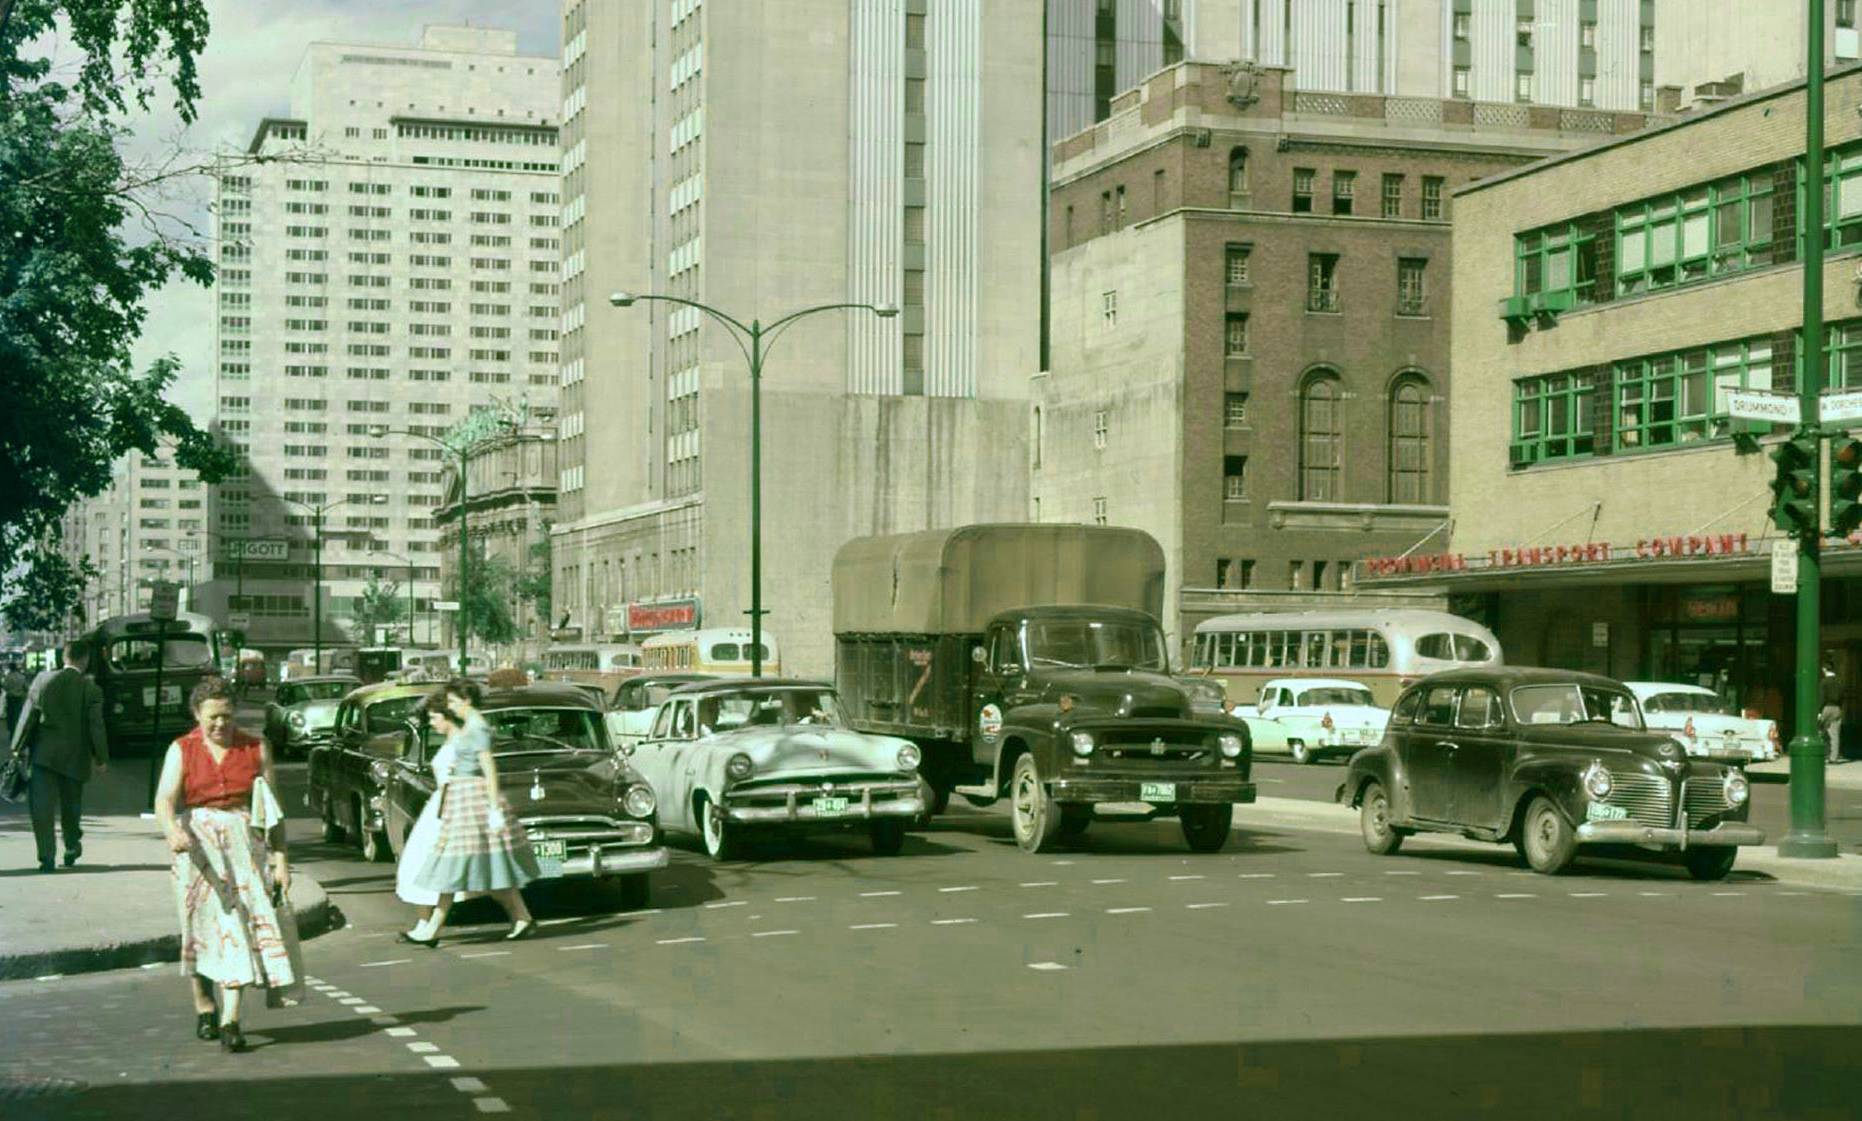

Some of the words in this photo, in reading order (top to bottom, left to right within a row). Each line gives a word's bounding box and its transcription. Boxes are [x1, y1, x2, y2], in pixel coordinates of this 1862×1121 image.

[1733, 399, 1787, 416] DRUMMOND
[1488, 542, 1611, 567] TRANSPORT
[1636, 533, 1748, 560] COMPANY
